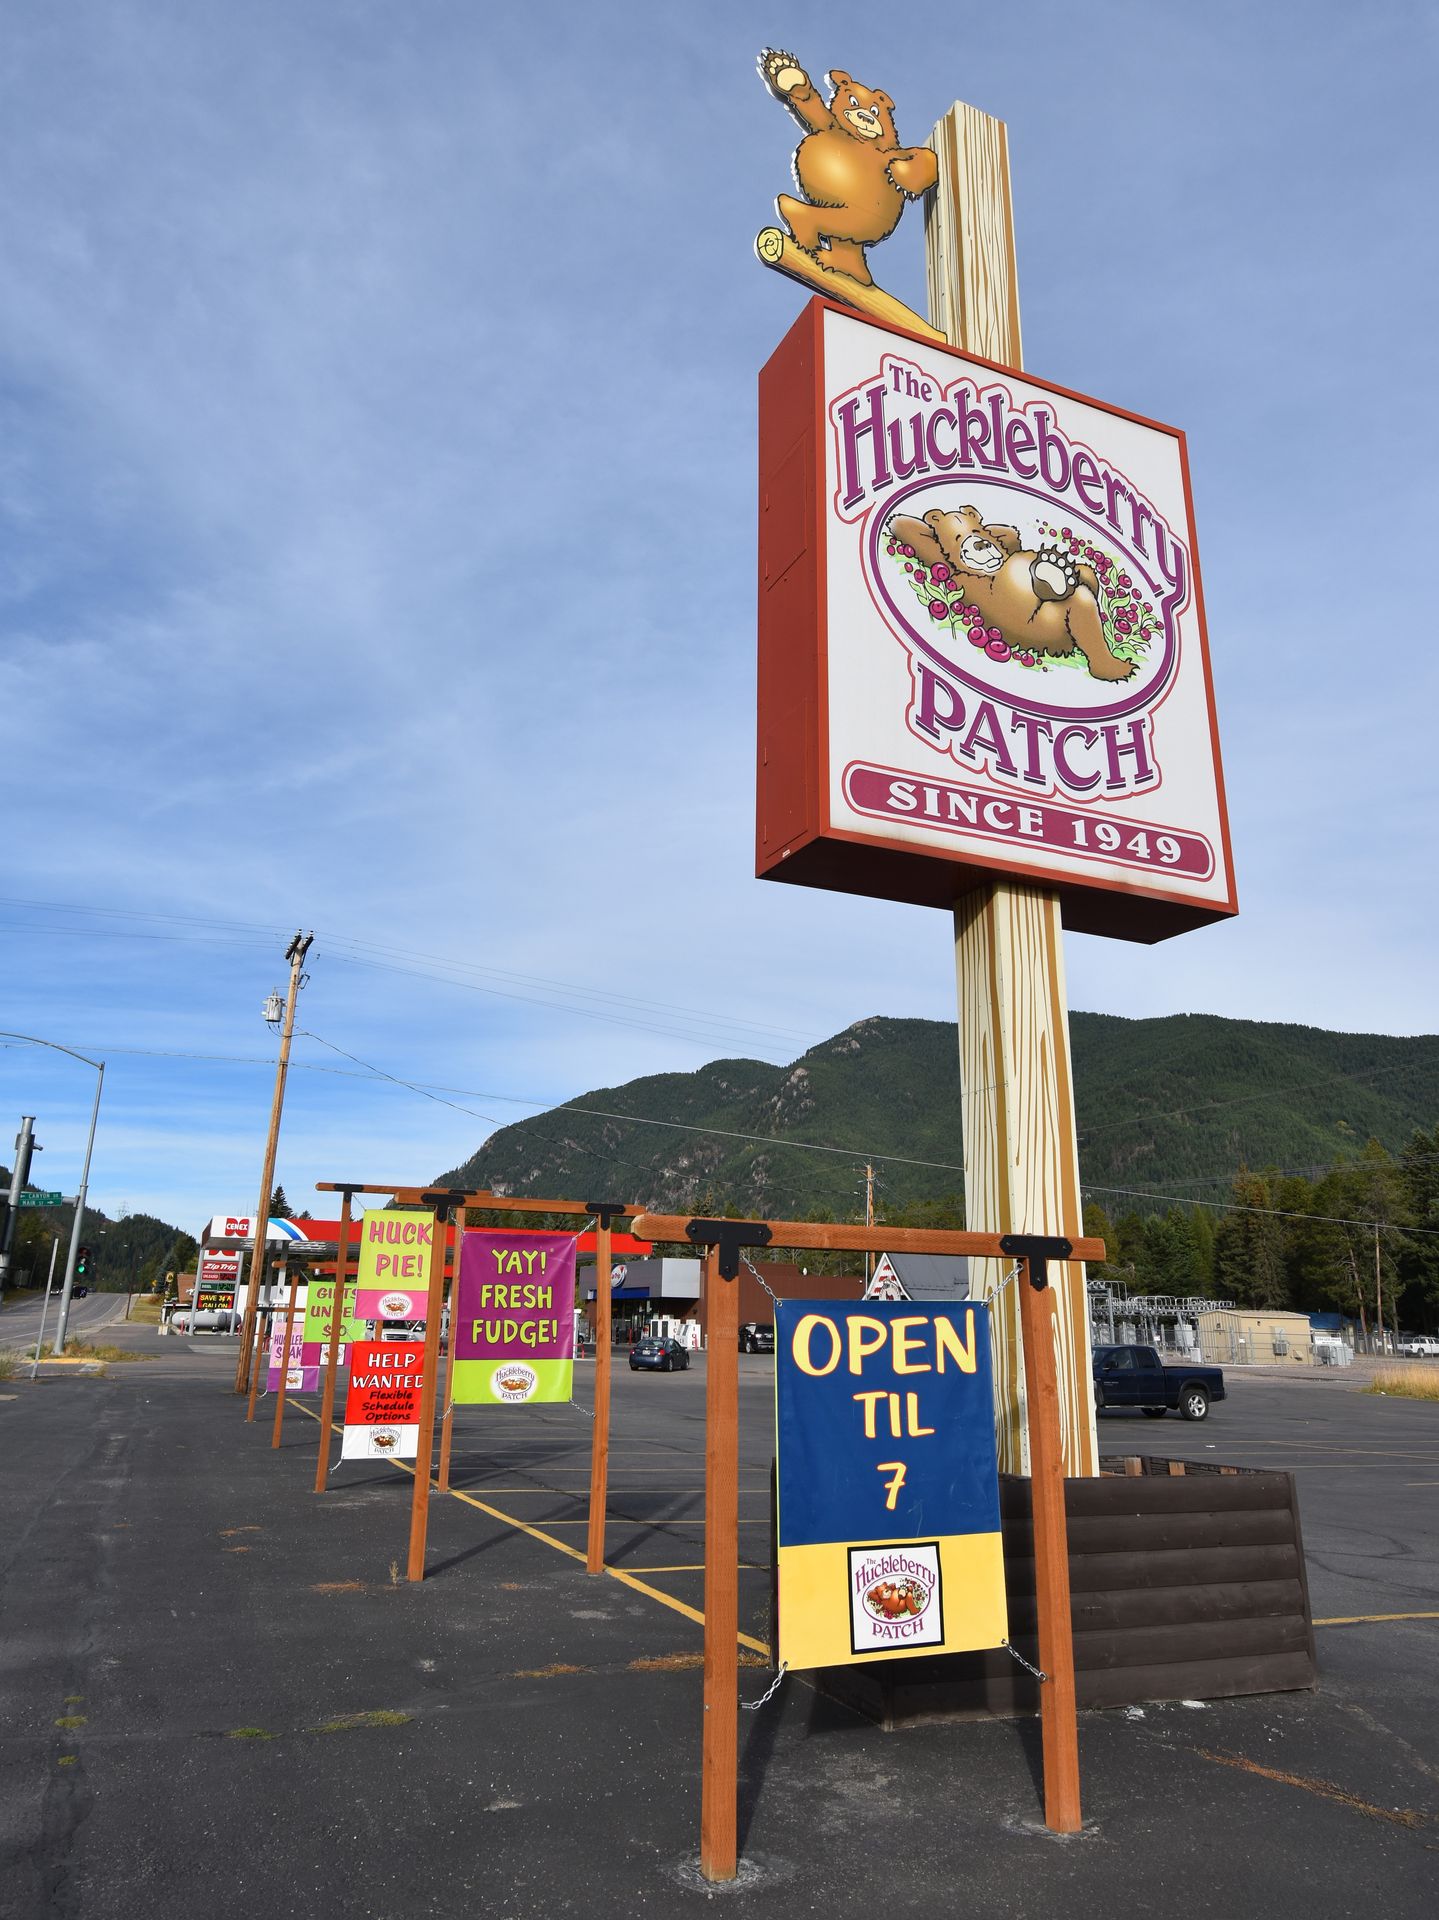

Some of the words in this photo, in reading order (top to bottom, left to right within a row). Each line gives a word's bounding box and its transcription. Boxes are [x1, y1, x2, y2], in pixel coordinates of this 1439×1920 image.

[889, 364, 932, 402] The
[838, 383, 1186, 603] Huckleberry
[916, 662, 1153, 791] PATCH
[886, 781, 1043, 837] SINCE
[1071, 819, 1181, 863] 1949
[226, 1223, 248, 1231] CENEX
[369, 1220, 433, 1245] HUCK
[203, 1263, 220, 1271] Zip
[220, 1263, 237, 1271] Trip
[376, 1254, 423, 1278] PIE!
[491, 1249, 547, 1275] YAY!
[317, 1287, 356, 1299] GITS
[481, 1284, 553, 1309] FRESH
[311, 1305, 356, 1318] UNE
[322, 1324, 347, 1338] $0
[472, 1319, 558, 1348] FUDGE!
[275, 1346, 302, 1359] SAK
[792, 1309, 978, 1376] OPEN
[368, 1353, 416, 1368] HELP
[496, 1366, 535, 1381] Huckleberry
[362, 1401, 414, 1411] Schedule
[369, 1390, 413, 1400] Flexible
[501, 1392, 528, 1400] PATCH
[365, 1412, 411, 1423] Options
[853, 1392, 935, 1438] TIL
[877, 1461, 907, 1511] 7
[855, 1554, 935, 1595] Huckleberry
[872, 1618, 924, 1639] PATCH
